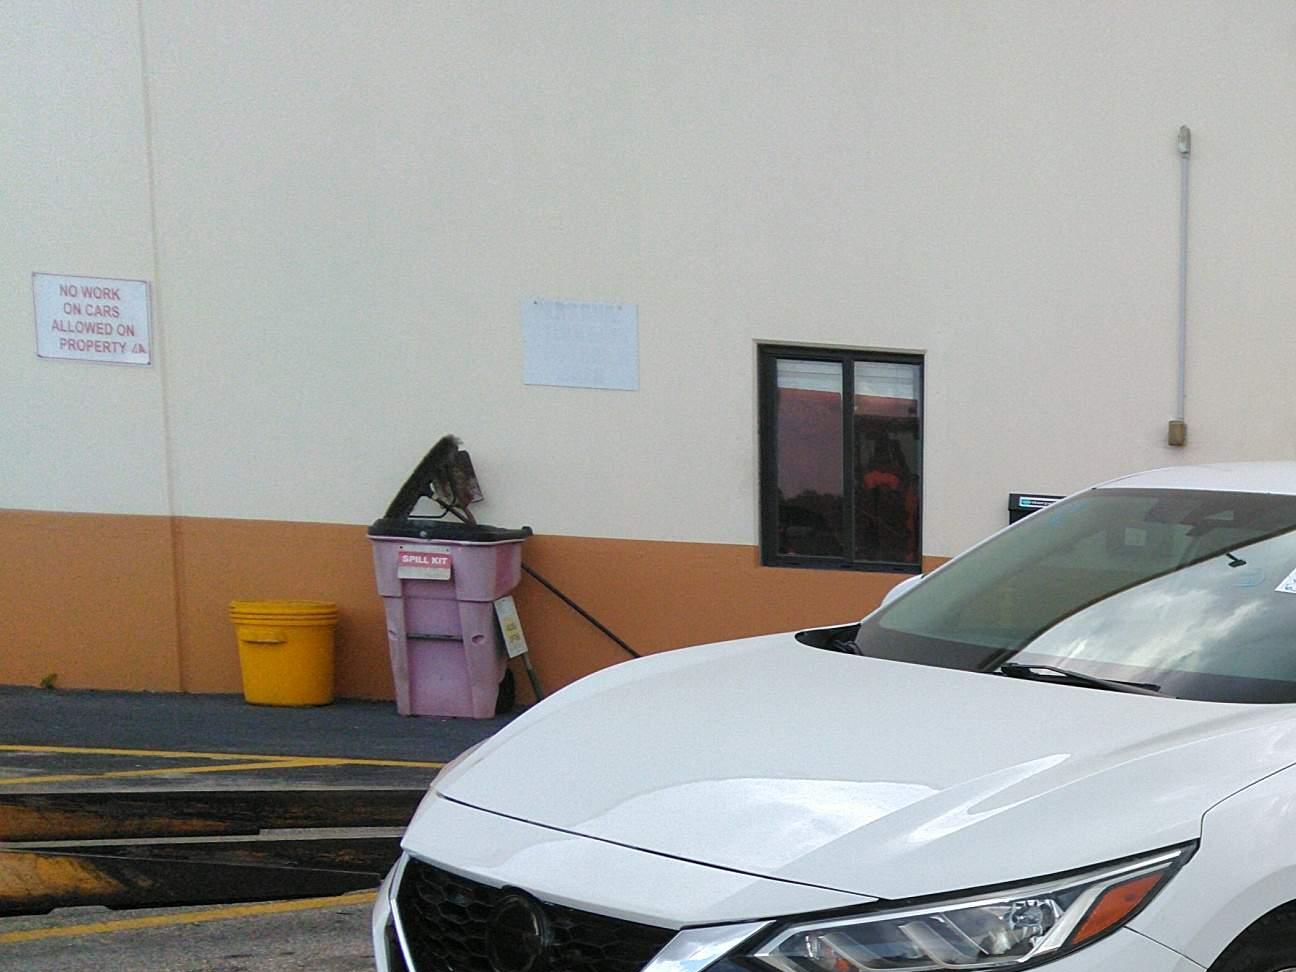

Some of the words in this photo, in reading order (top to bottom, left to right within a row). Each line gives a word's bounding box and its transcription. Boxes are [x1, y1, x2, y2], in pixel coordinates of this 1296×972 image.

[59, 284, 78, 297] NO
[81, 286, 121, 300] WORK
[63, 302, 81, 315] ON
[85, 304, 120, 318] CARS
[51, 319, 113, 336] ALLOWED
[117, 324, 135, 336] ON
[59, 338, 127, 353] PROPERTY
[402, 554, 429, 564] SPILL
[431, 556, 449, 565] KIT
